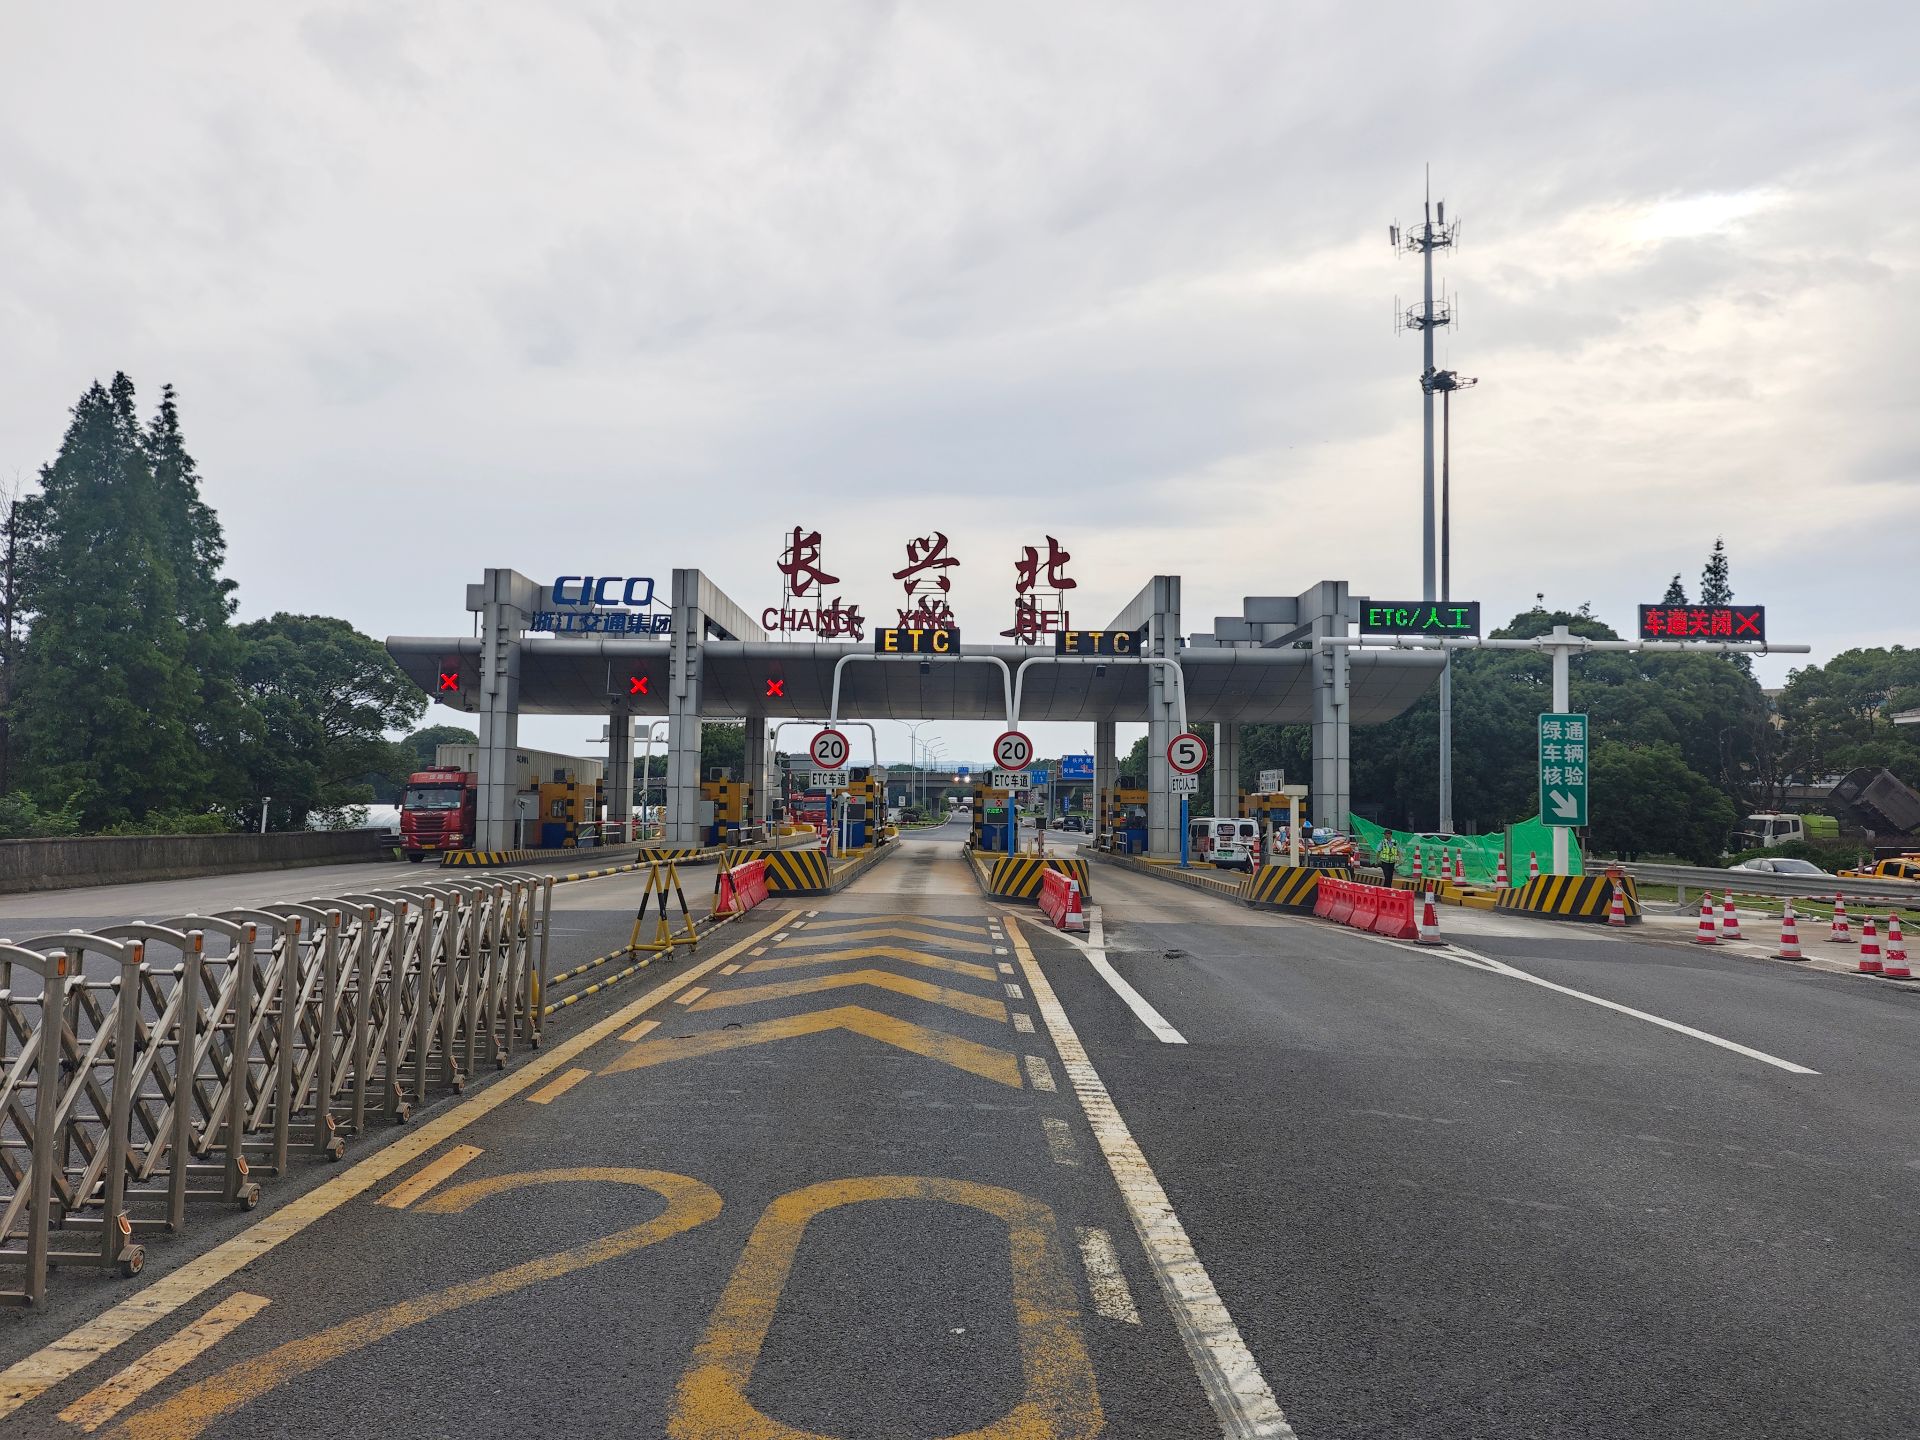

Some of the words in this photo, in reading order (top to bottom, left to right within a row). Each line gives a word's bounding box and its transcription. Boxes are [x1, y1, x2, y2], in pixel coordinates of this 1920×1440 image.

[777, 526, 1077, 597] 长兴北
[552, 576, 655, 606] CICO
[530, 611, 671, 634] 浙江交通集团
[1369, 607, 1471, 629] ETC/人工
[884, 629, 949, 652] ETC
[1065, 632, 1130, 653] ETC
[1542, 721, 1584, 740] 绿通
[818, 740, 843, 759] 20
[1001, 741, 1026, 760] 20
[1179, 743, 1196, 764] 5
[1542, 743, 1584, 763] 车辆
[812, 773, 846, 786] ETC车道
[994, 774, 1029, 788] ETC车道
[1542, 766, 1584, 786] 核验
